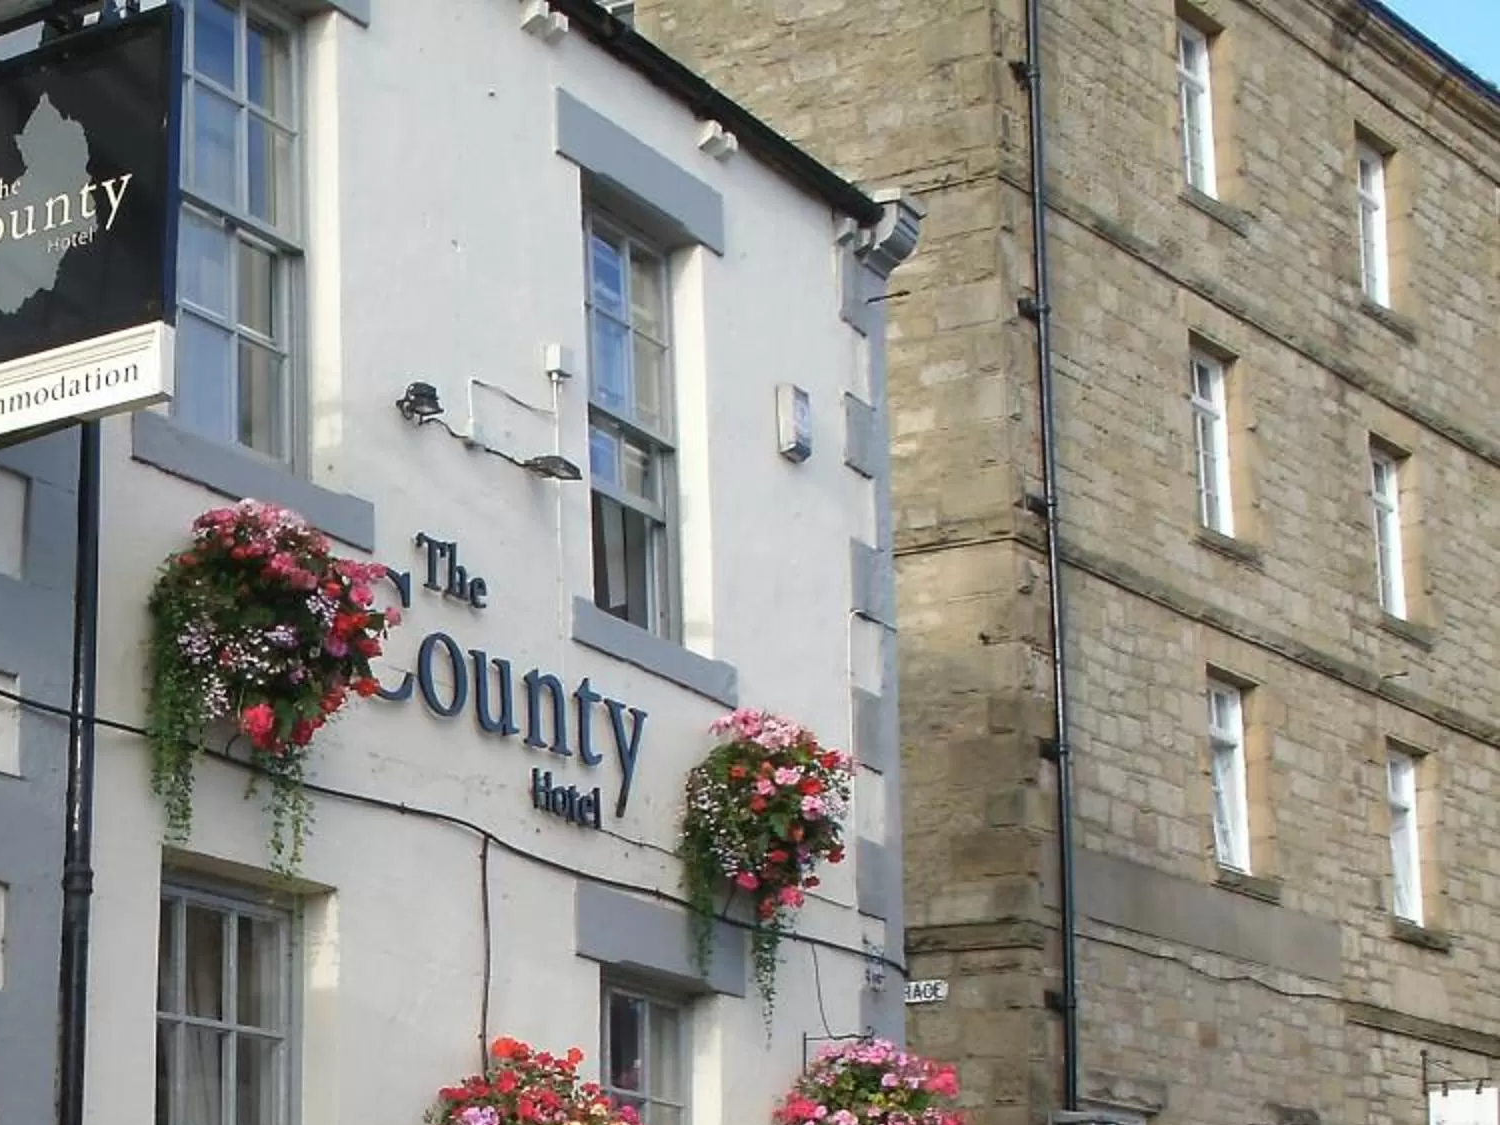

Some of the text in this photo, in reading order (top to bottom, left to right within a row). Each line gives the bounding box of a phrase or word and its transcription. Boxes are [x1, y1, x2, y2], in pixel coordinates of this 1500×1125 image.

[47, 226, 94, 253] Hotel
[414, 531, 488, 609] The
[532, 767, 601, 830] Hotel
